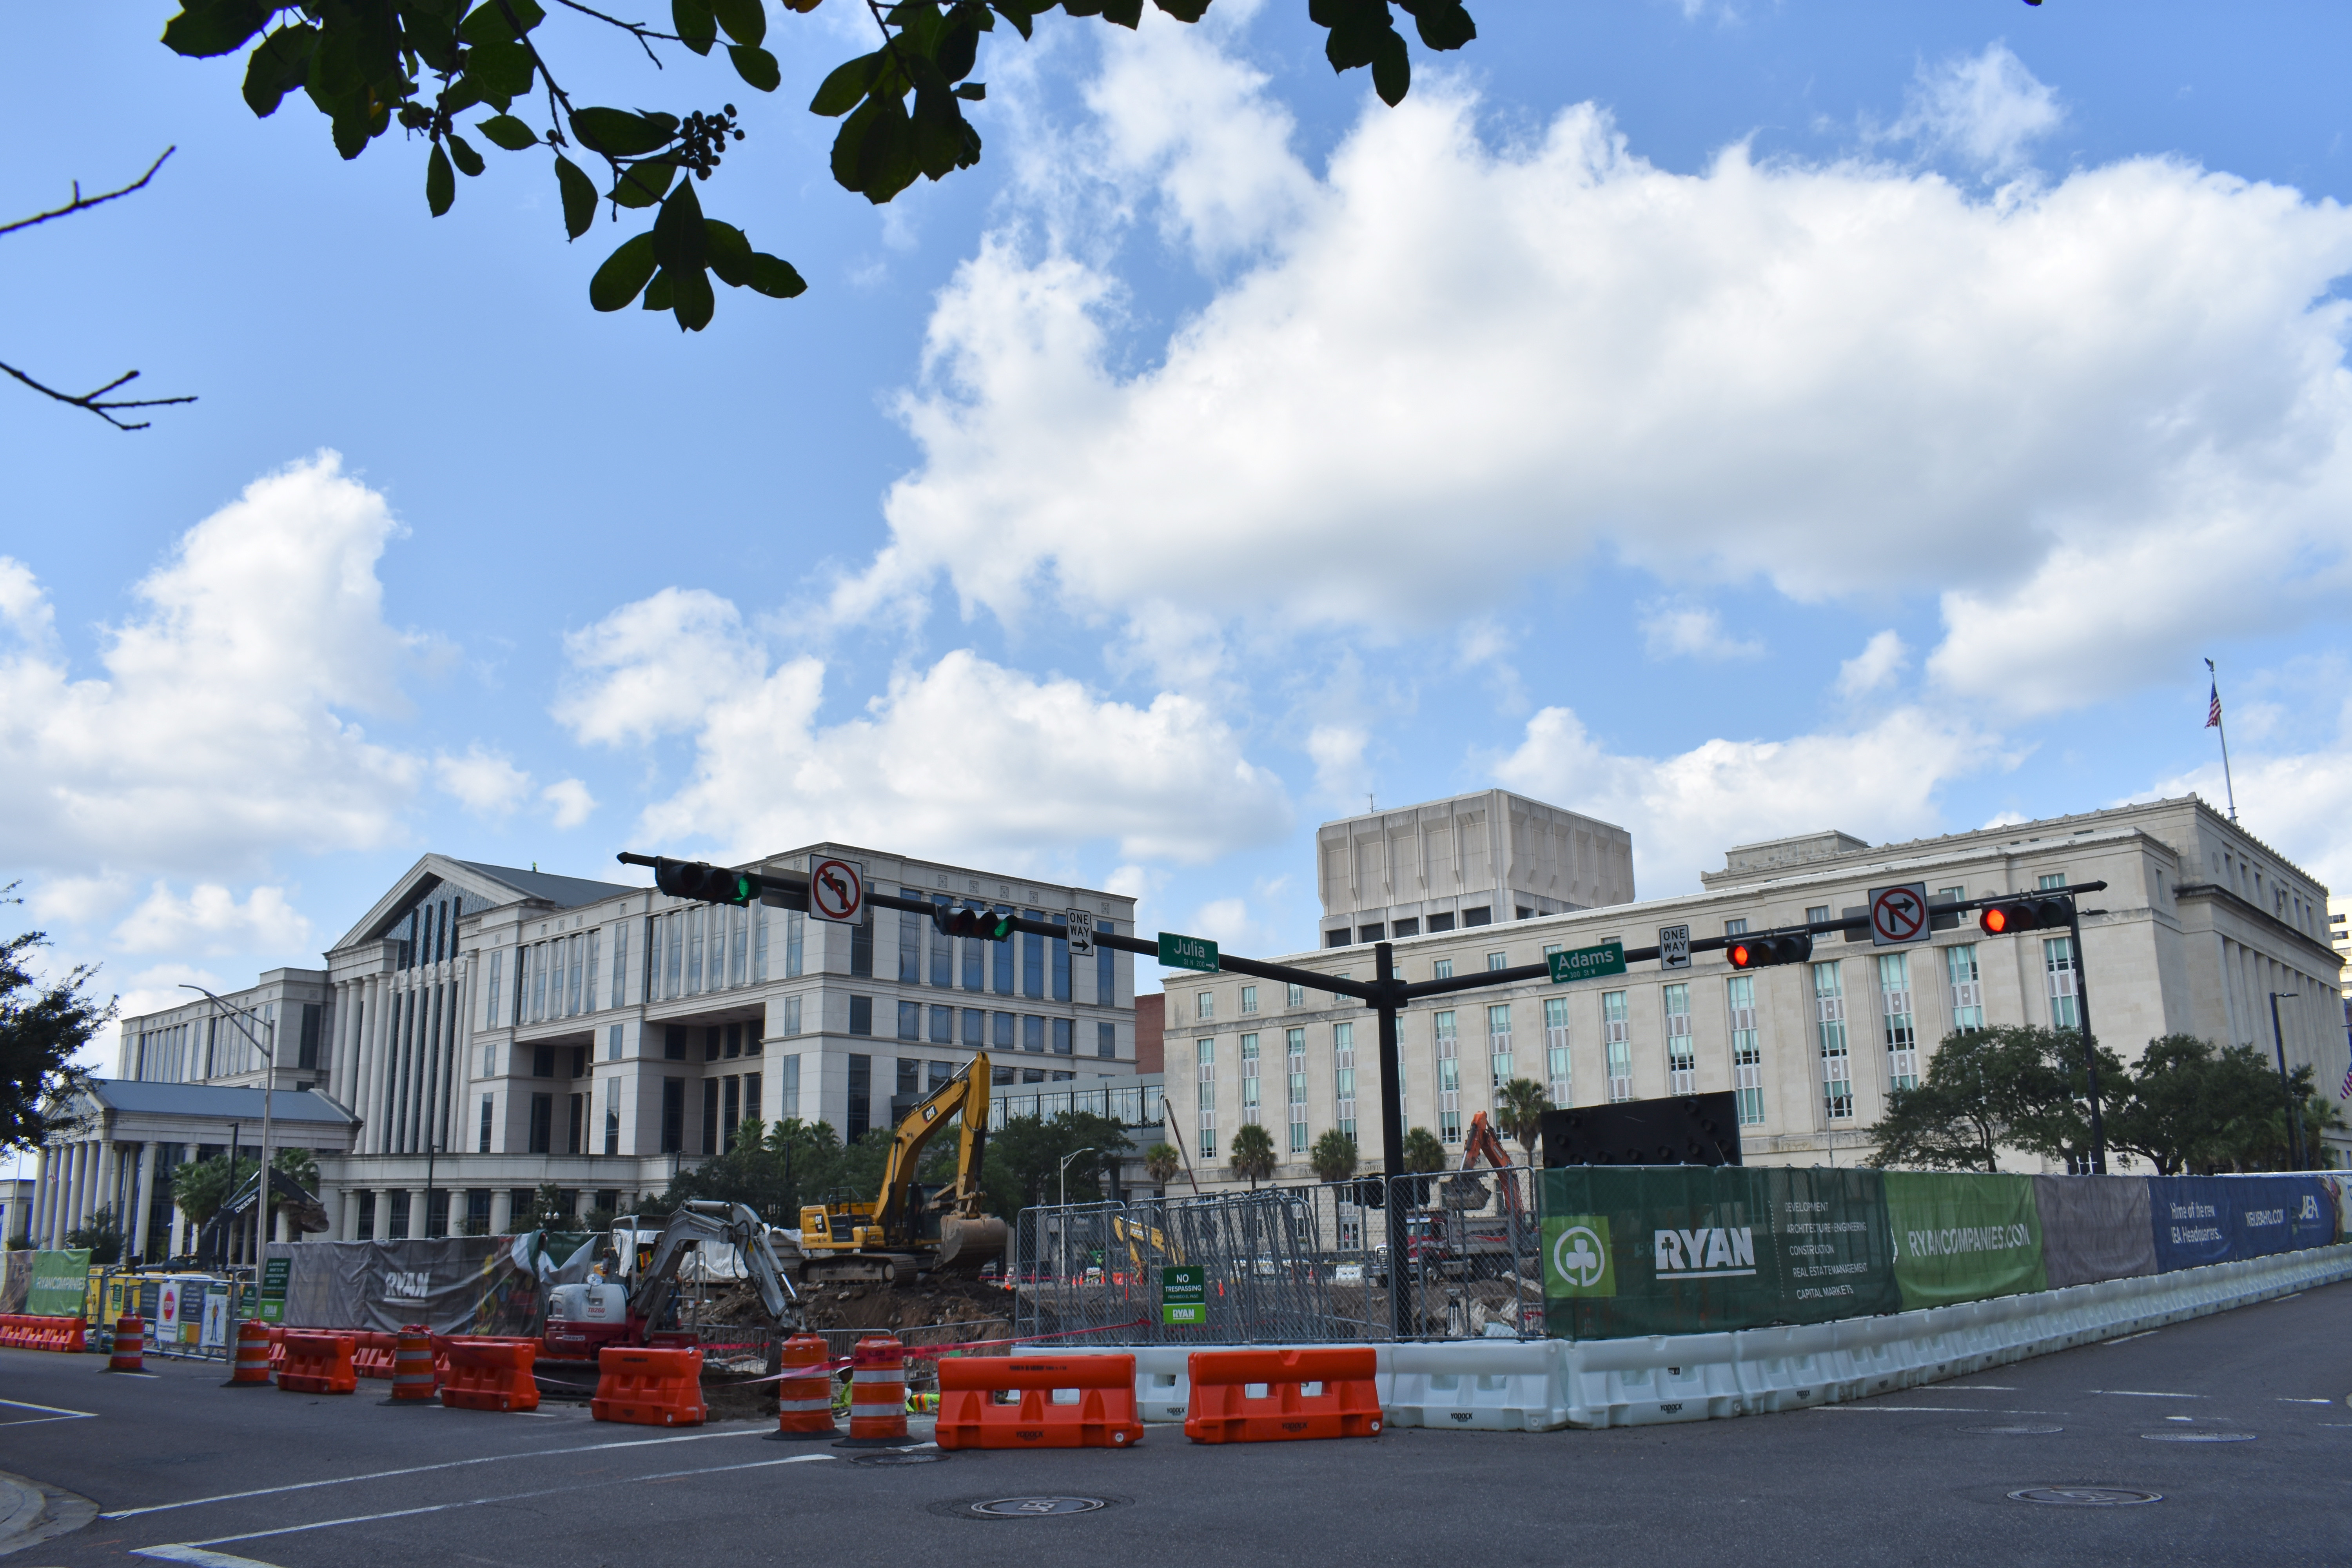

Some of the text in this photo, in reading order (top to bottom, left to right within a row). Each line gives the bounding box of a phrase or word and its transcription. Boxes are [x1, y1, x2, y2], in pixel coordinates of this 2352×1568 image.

[1070, 912, 1089, 925] ONE
[1070, 925, 1089, 937] WAY
[1664, 929, 1685, 940] ONE
[1174, 939, 1205, 958] Julia
[1664, 940, 1686, 953] WAY
[1558, 950, 1614, 971] Adams
[926, 1106, 935, 1120] CAT
[235, 1194, 257, 1213] DEERE
[1785, 1202, 1828, 1212] DEVELOPMENT
[2188, 1201, 2195, 1218] of
[2196, 1201, 2204, 1218] he
[2298, 1195, 2319, 1220] JEA
[1787, 1223, 1831, 1234] ARCHITECTURE
[1834, 1221, 1867, 1232] ENGINEERING
[1908, 1222, 2030, 1257] RYANCOMPANIES.COM
[2181, 1225, 2222, 1246] Headquarers.
[1655, 1227, 1755, 1270] RYAN
[1790, 1244, 1835, 1256] CONSTRUCTION
[1793, 1263, 1868, 1278] REAL ESTATE MANAGEMENT
[385, 1272, 430, 1297] RYAN
[1176, 1274, 1189, 1283] NO
[1797, 1285, 1853, 1299] CAPITAL MARKETS
[164, 1301, 174, 1310] STOP
[1173, 1309, 1194, 1318] RYAN
[1660, 1402, 1683, 1411] YODOCK
[1282, 1421, 1308, 1430] YODOCK
